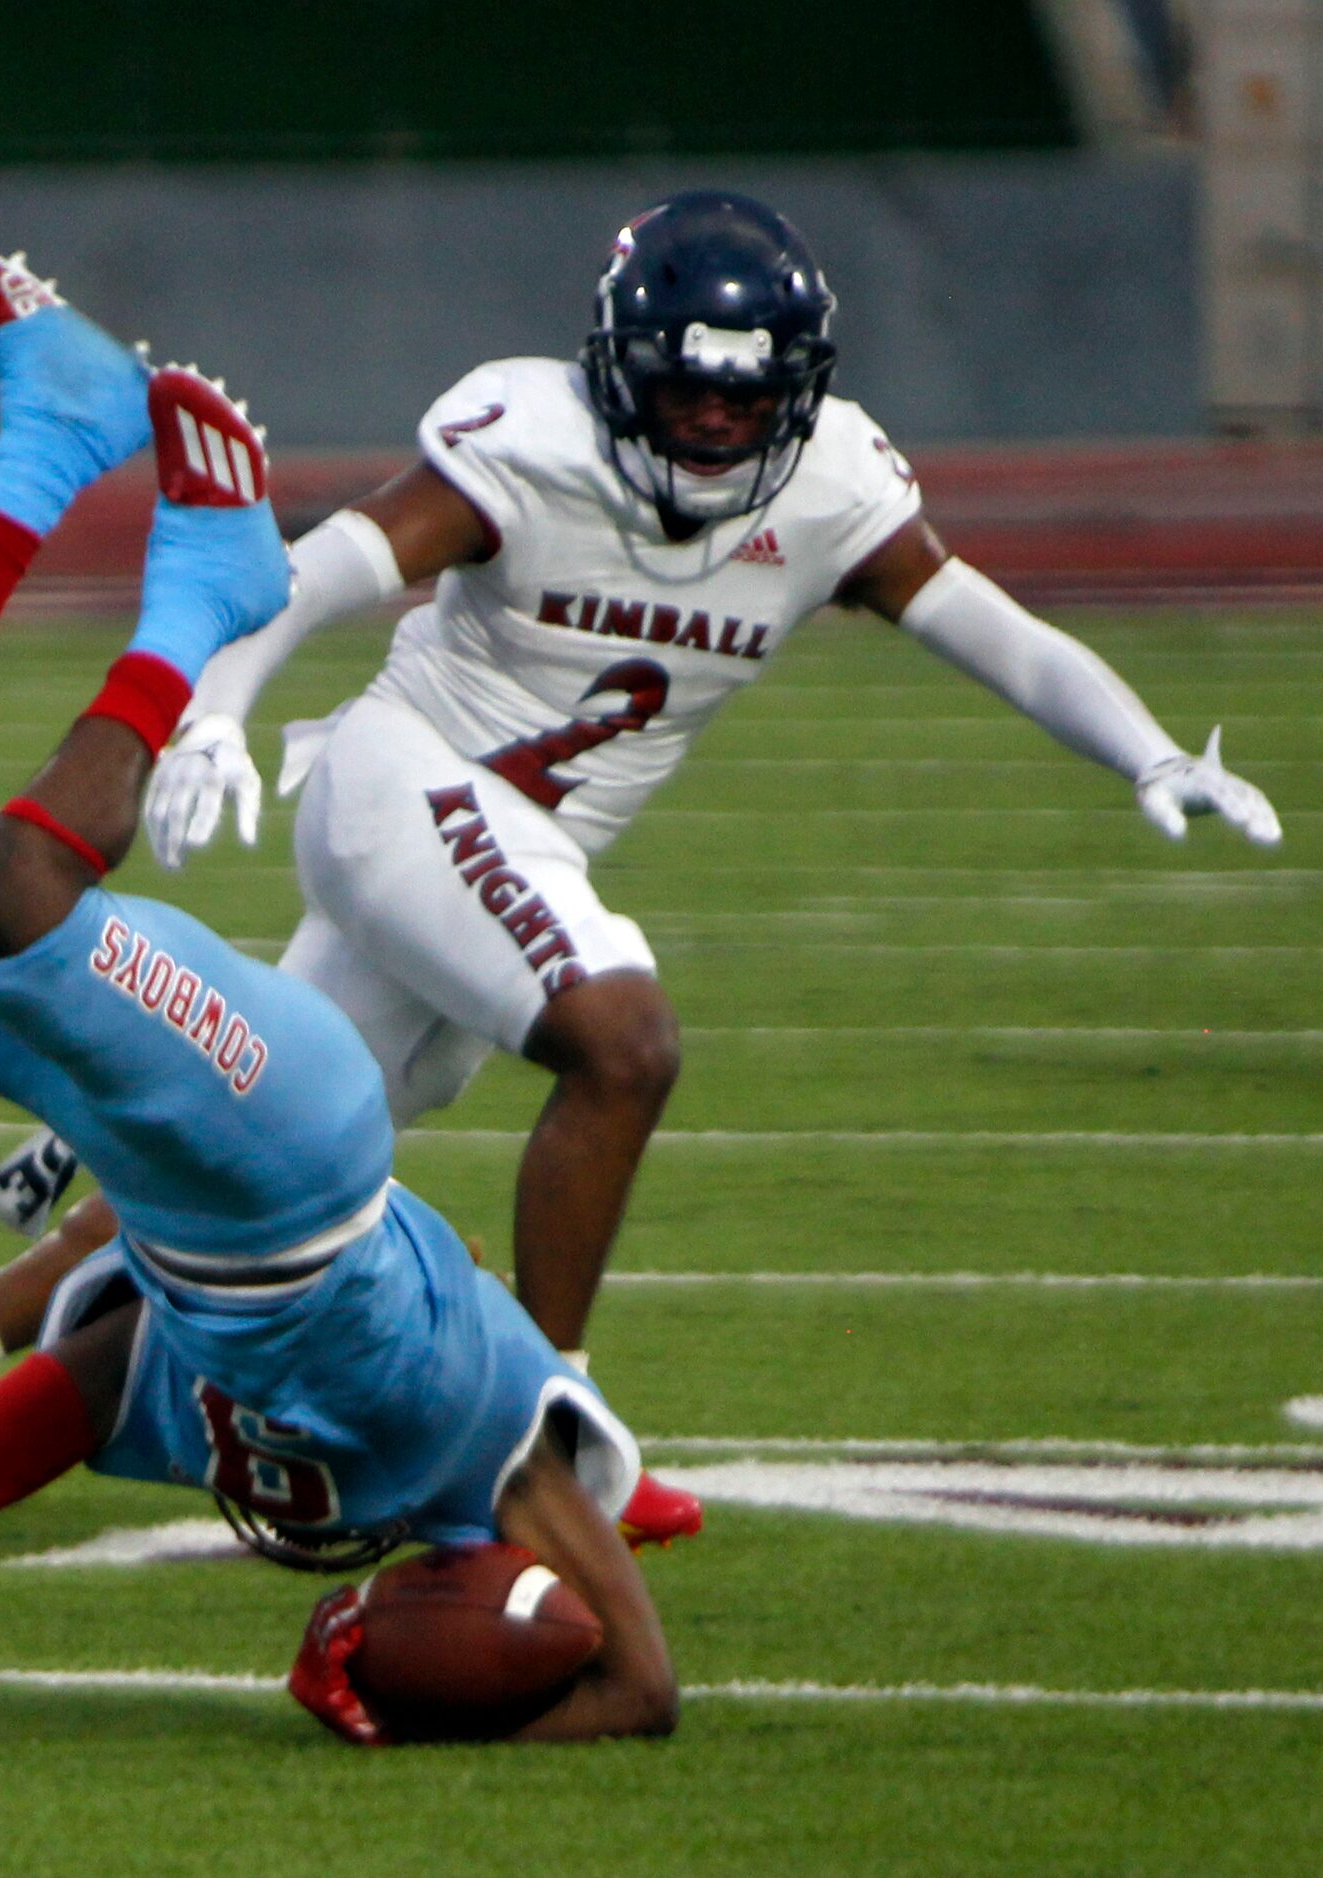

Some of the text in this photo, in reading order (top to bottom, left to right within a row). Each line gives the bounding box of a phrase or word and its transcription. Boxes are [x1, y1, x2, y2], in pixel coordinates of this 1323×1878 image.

[537, 590, 769, 659] KIMBALL
[477, 656, 671, 811] 2
[425, 782, 588, 1001] KNIGHTS
[90, 914, 267, 1095] COWBOYS
